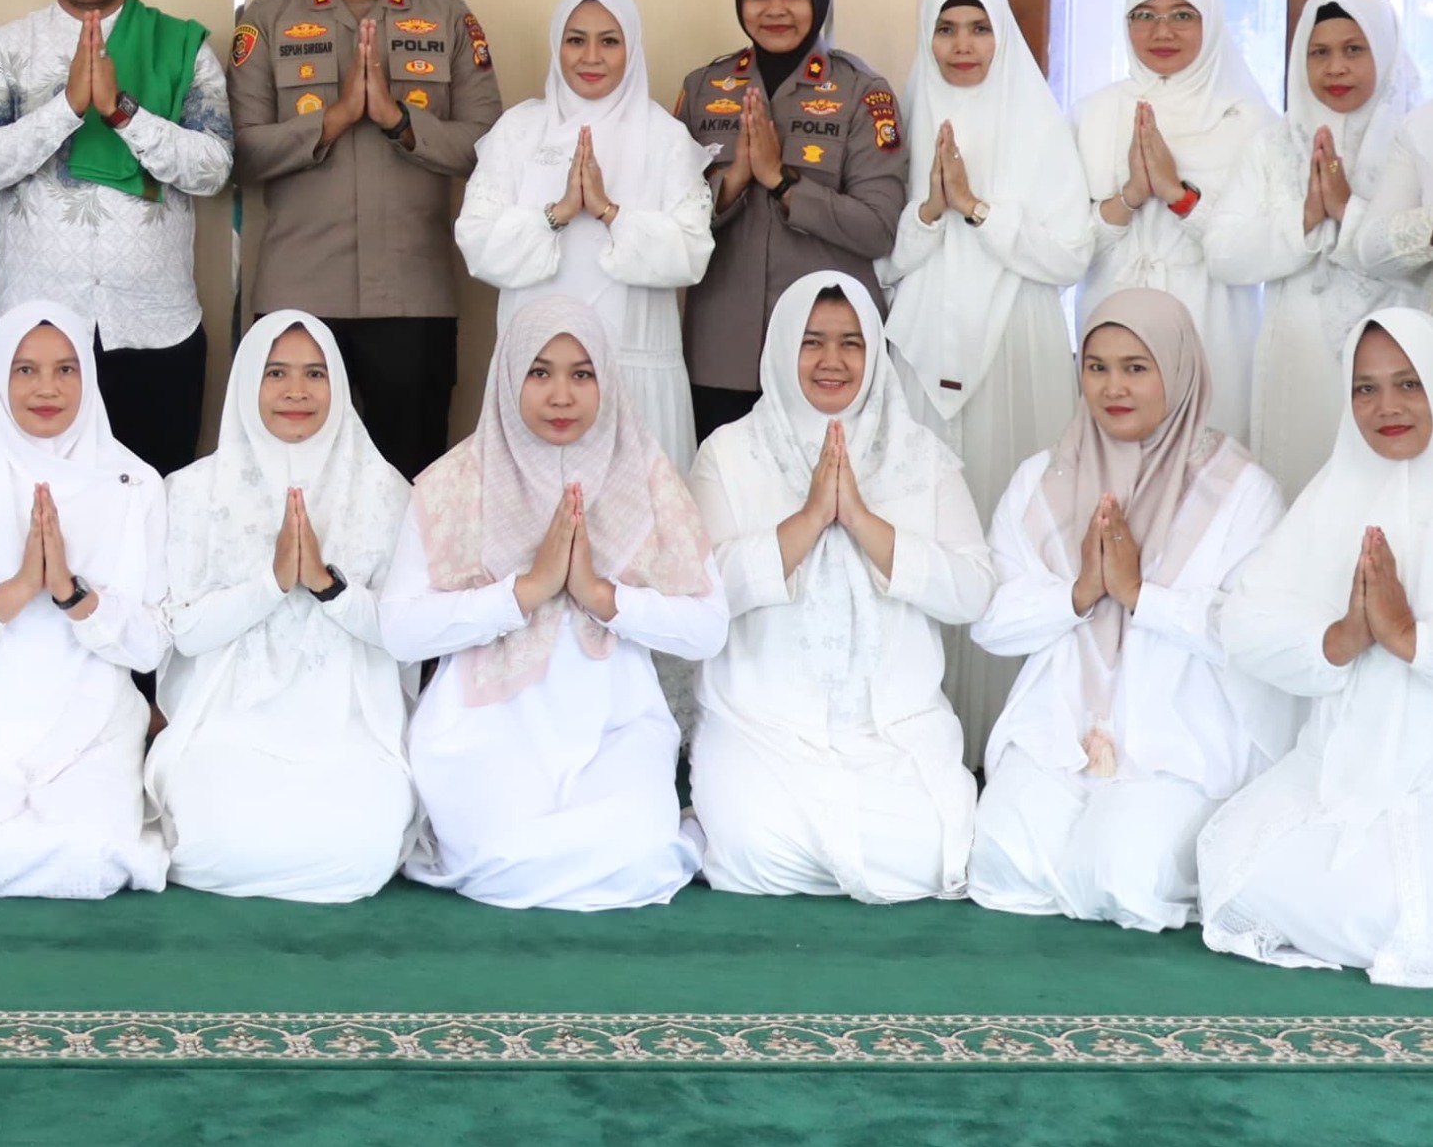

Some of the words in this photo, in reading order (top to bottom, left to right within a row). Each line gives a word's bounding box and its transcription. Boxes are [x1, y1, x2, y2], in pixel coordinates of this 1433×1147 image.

[279, 43, 303, 57] SEPUH
[391, 39, 445, 53] POLRI
[698, 117, 740, 133] AKIRA
[791, 120, 840, 137] POLRI
